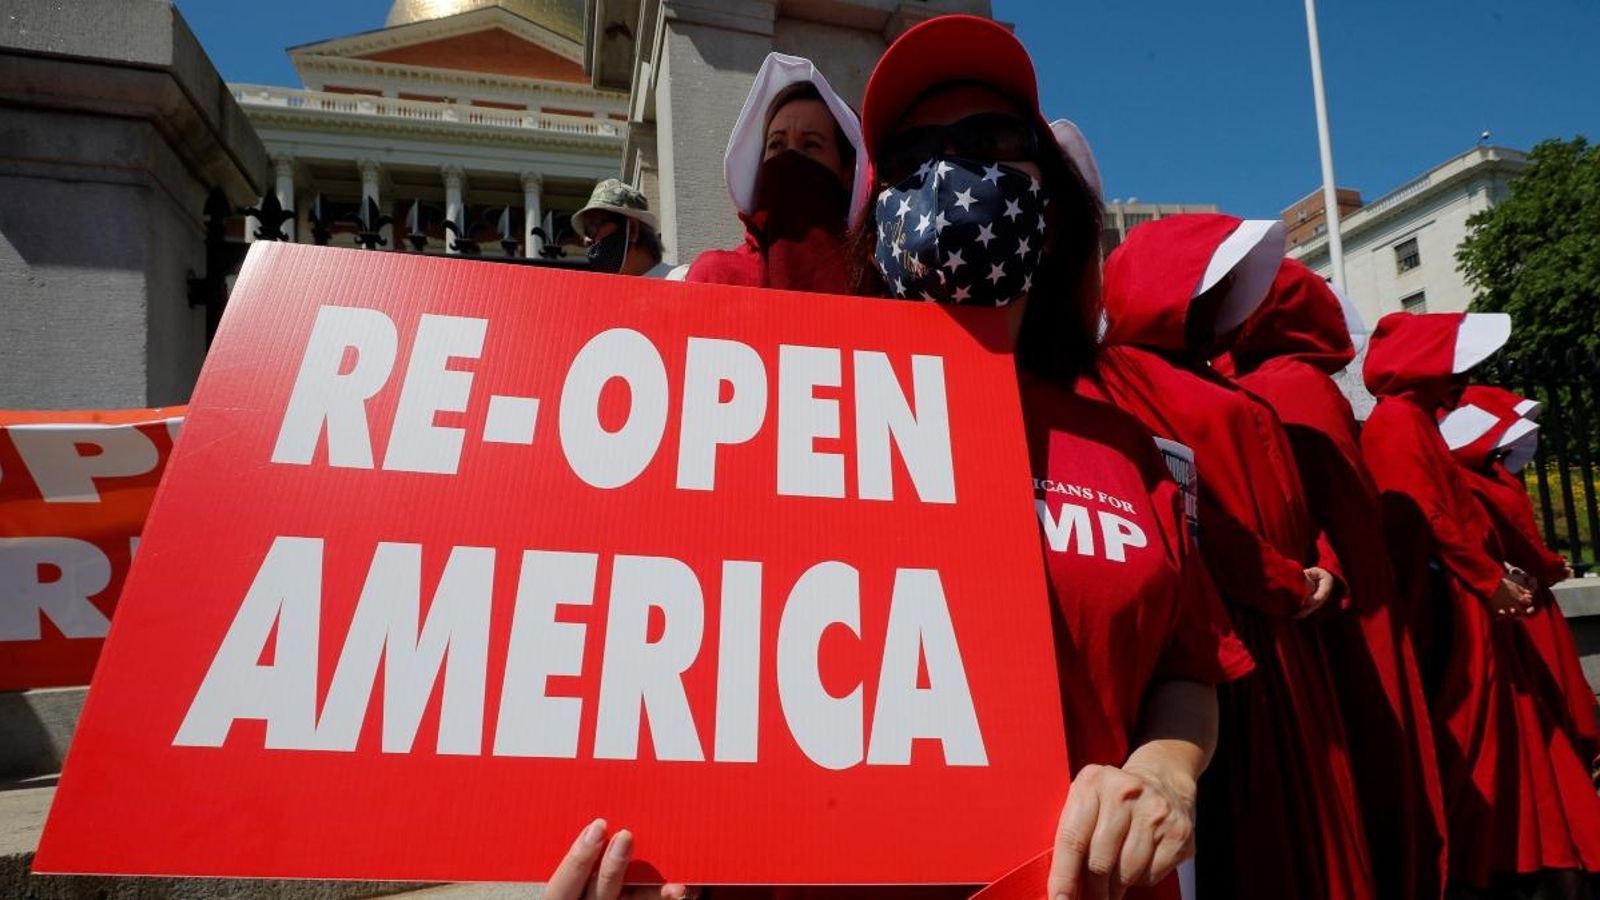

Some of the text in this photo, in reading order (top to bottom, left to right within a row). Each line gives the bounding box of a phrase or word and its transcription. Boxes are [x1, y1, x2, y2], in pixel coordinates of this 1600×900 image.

[271, 304, 957, 504] RE-OPEN
[1096, 491, 1137, 515] FOR
[172, 535, 989, 770] AMERICA
